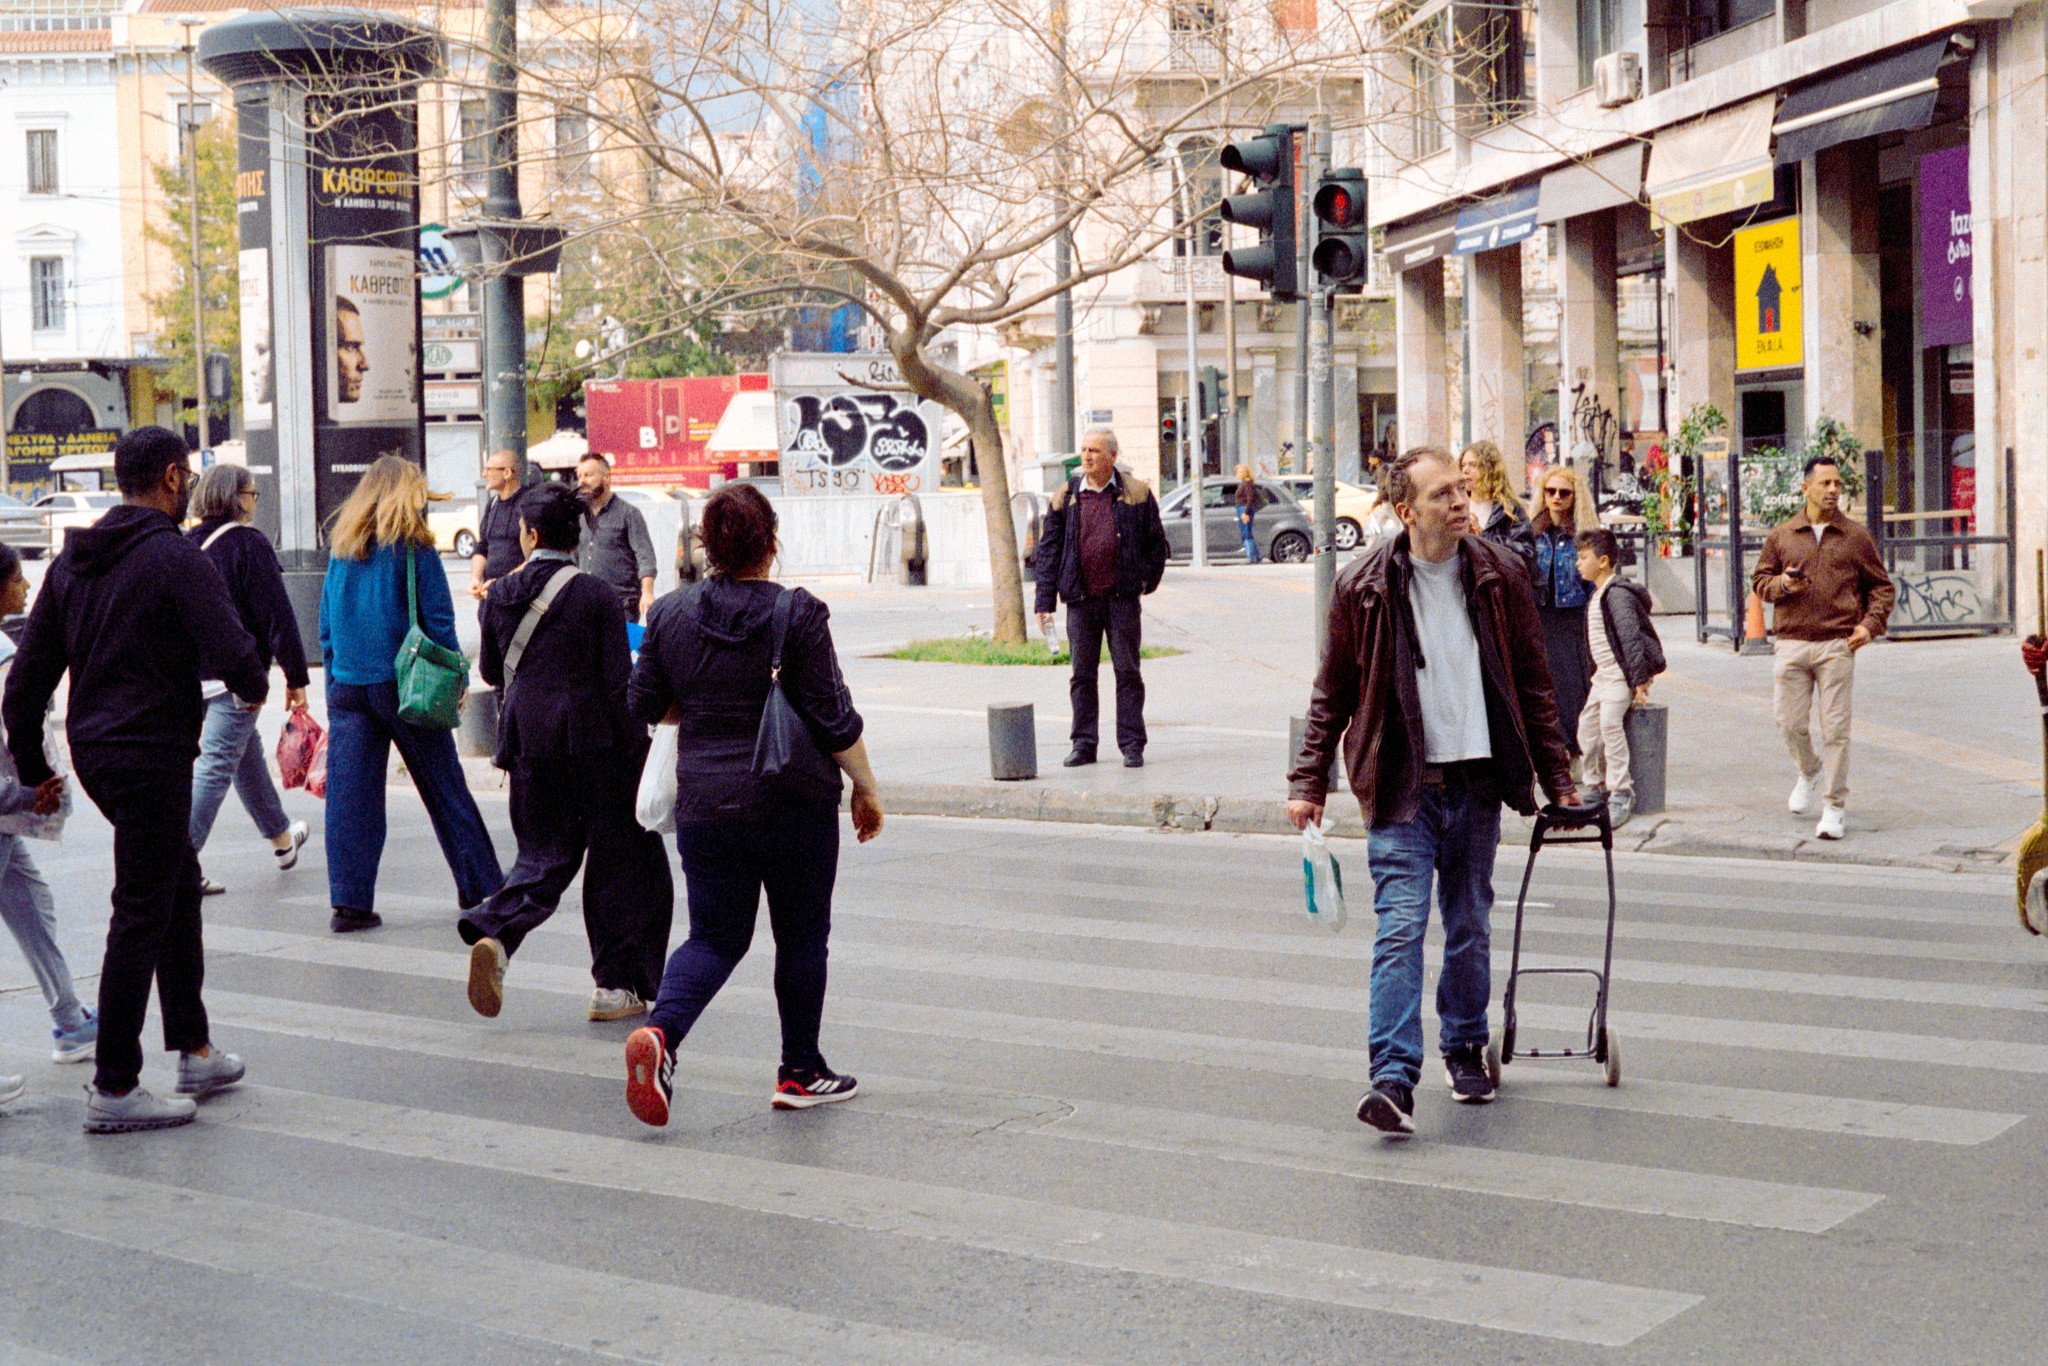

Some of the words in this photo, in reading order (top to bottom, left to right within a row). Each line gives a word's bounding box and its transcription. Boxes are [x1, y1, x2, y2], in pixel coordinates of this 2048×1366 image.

[1951, 209, 1971, 236] taz
[66, 431, 117, 445] ΔΑΝΕΙΑ
[1763, 494, 1799, 506] coffee
